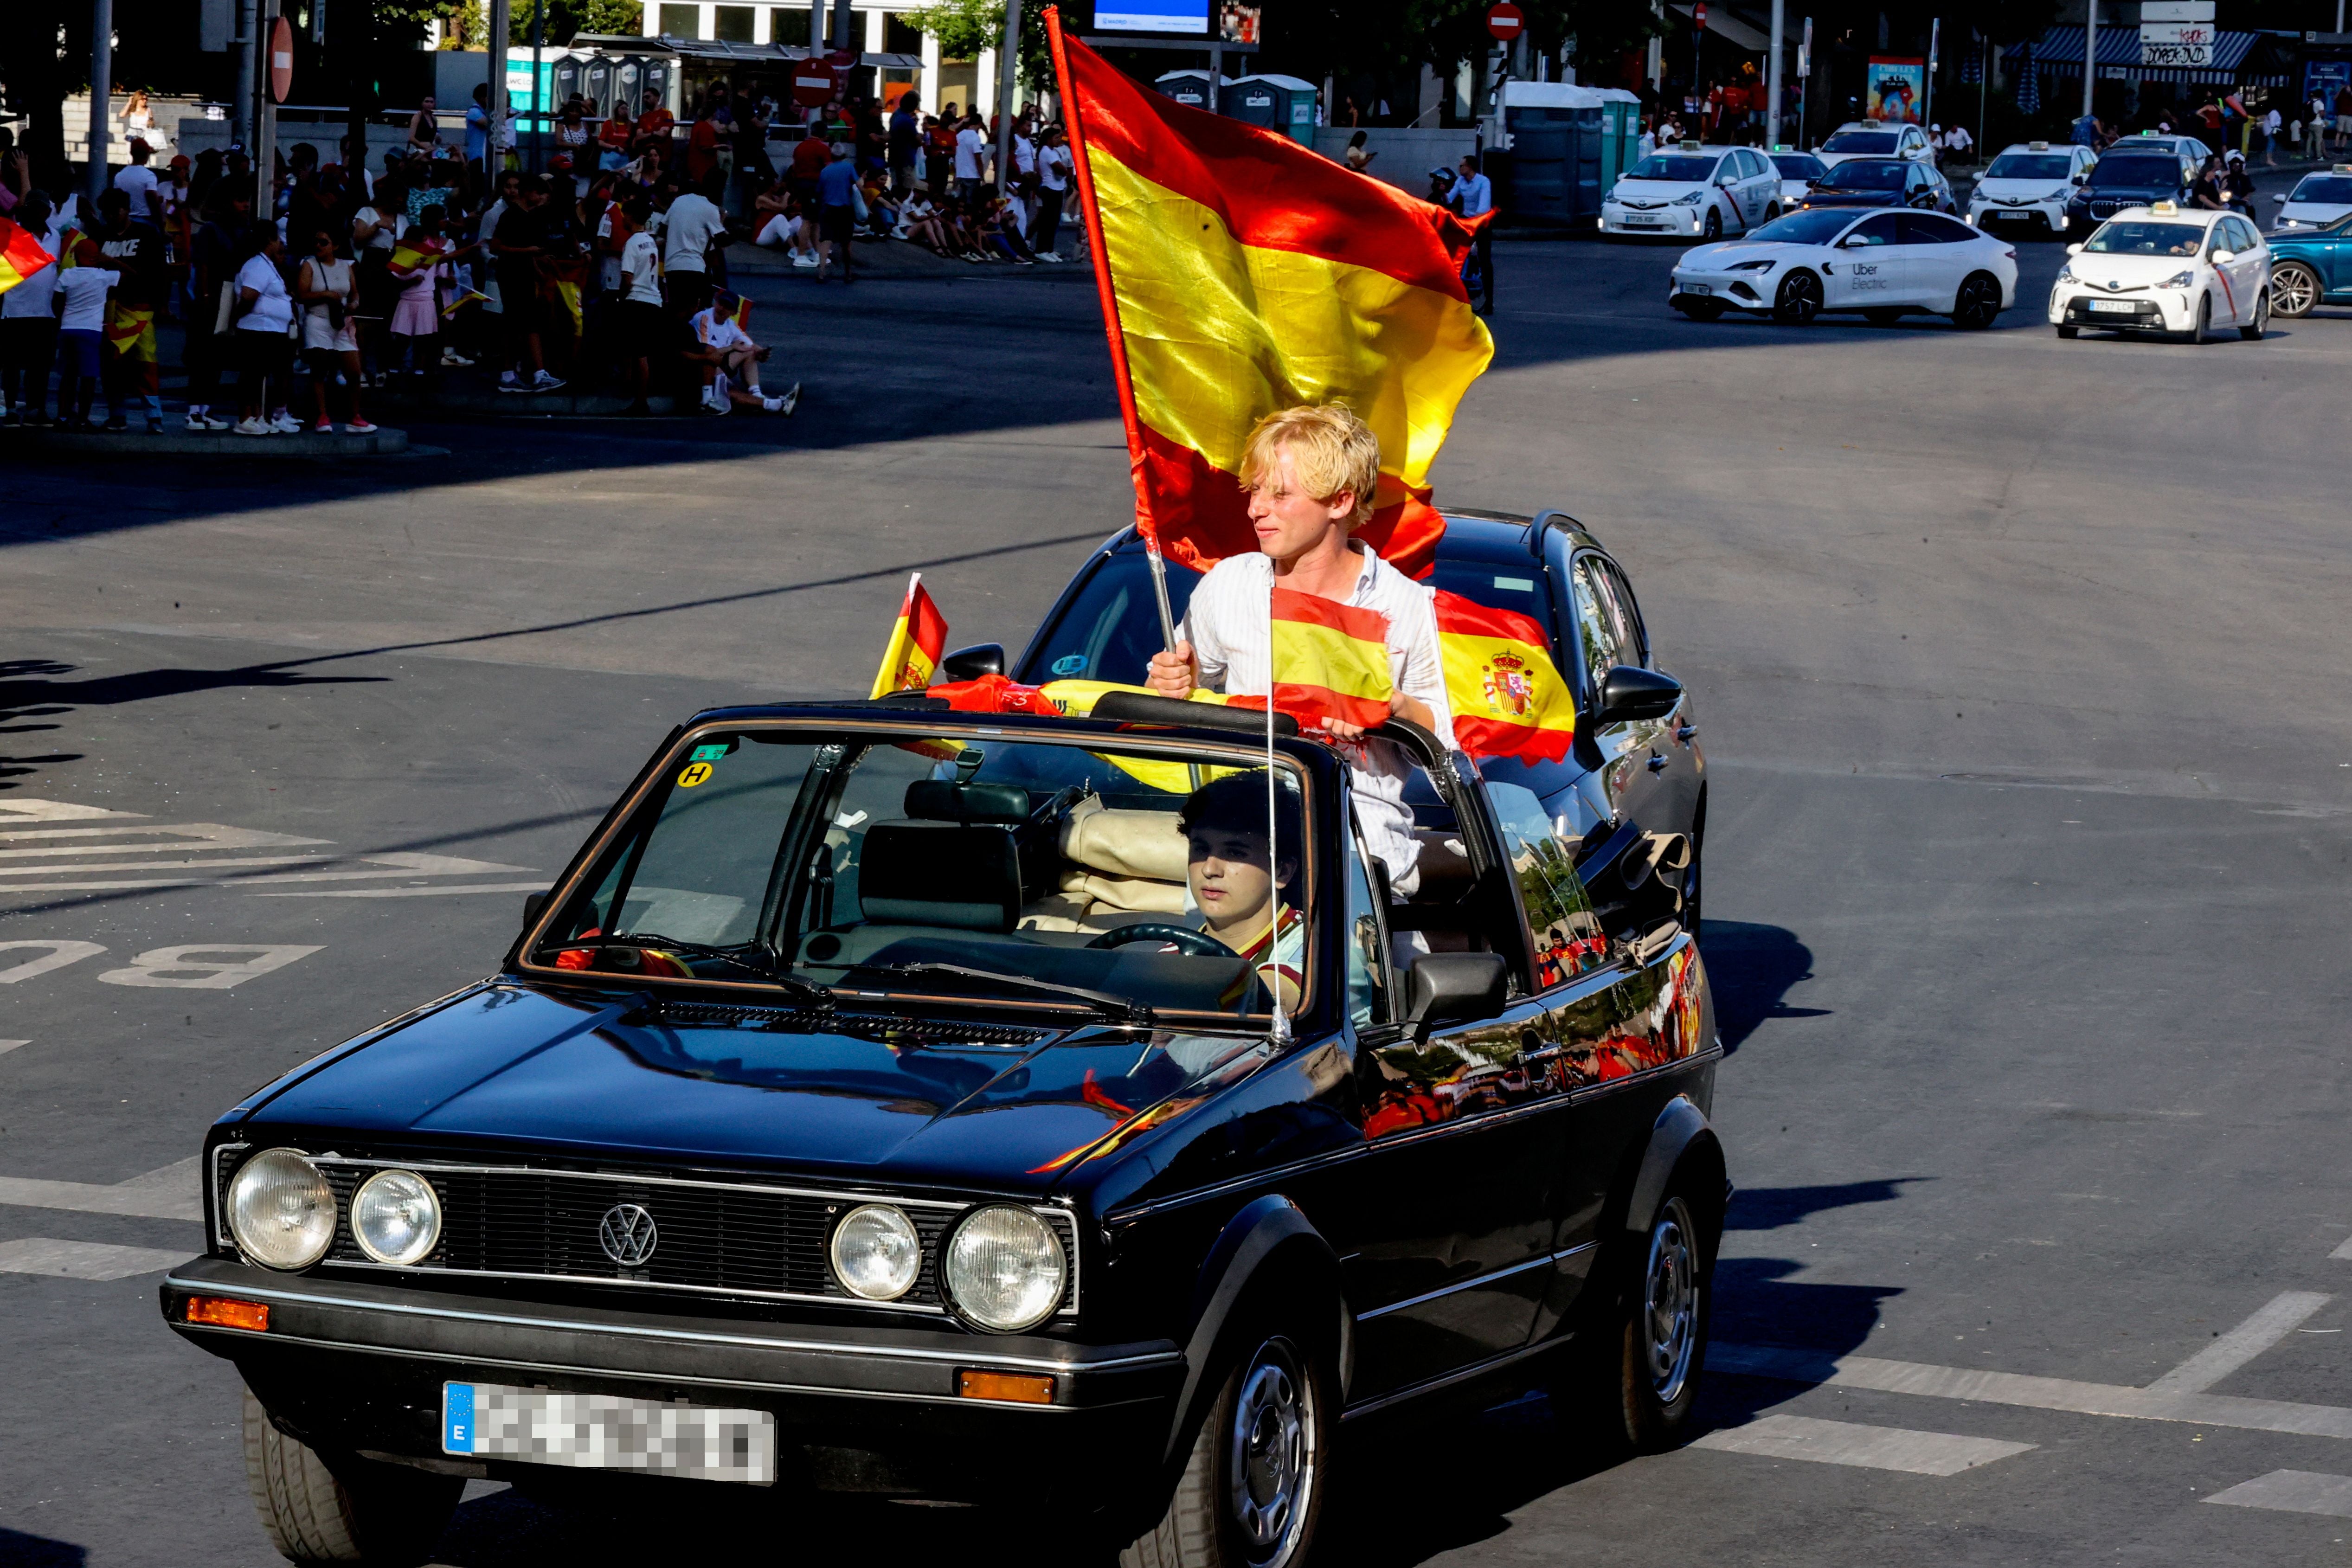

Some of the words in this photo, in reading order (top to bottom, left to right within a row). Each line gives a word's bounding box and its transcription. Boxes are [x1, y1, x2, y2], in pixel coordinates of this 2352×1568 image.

[101, 238, 140, 258] NIKE
[1853, 263, 1878, 275] Uber
[1852, 278, 1887, 289] Electric
[2095, 302, 2114, 310] 3757
[682, 766, 707, 783] H
[601, 1207, 655, 1263] VW
[453, 1425, 465, 1440] E
